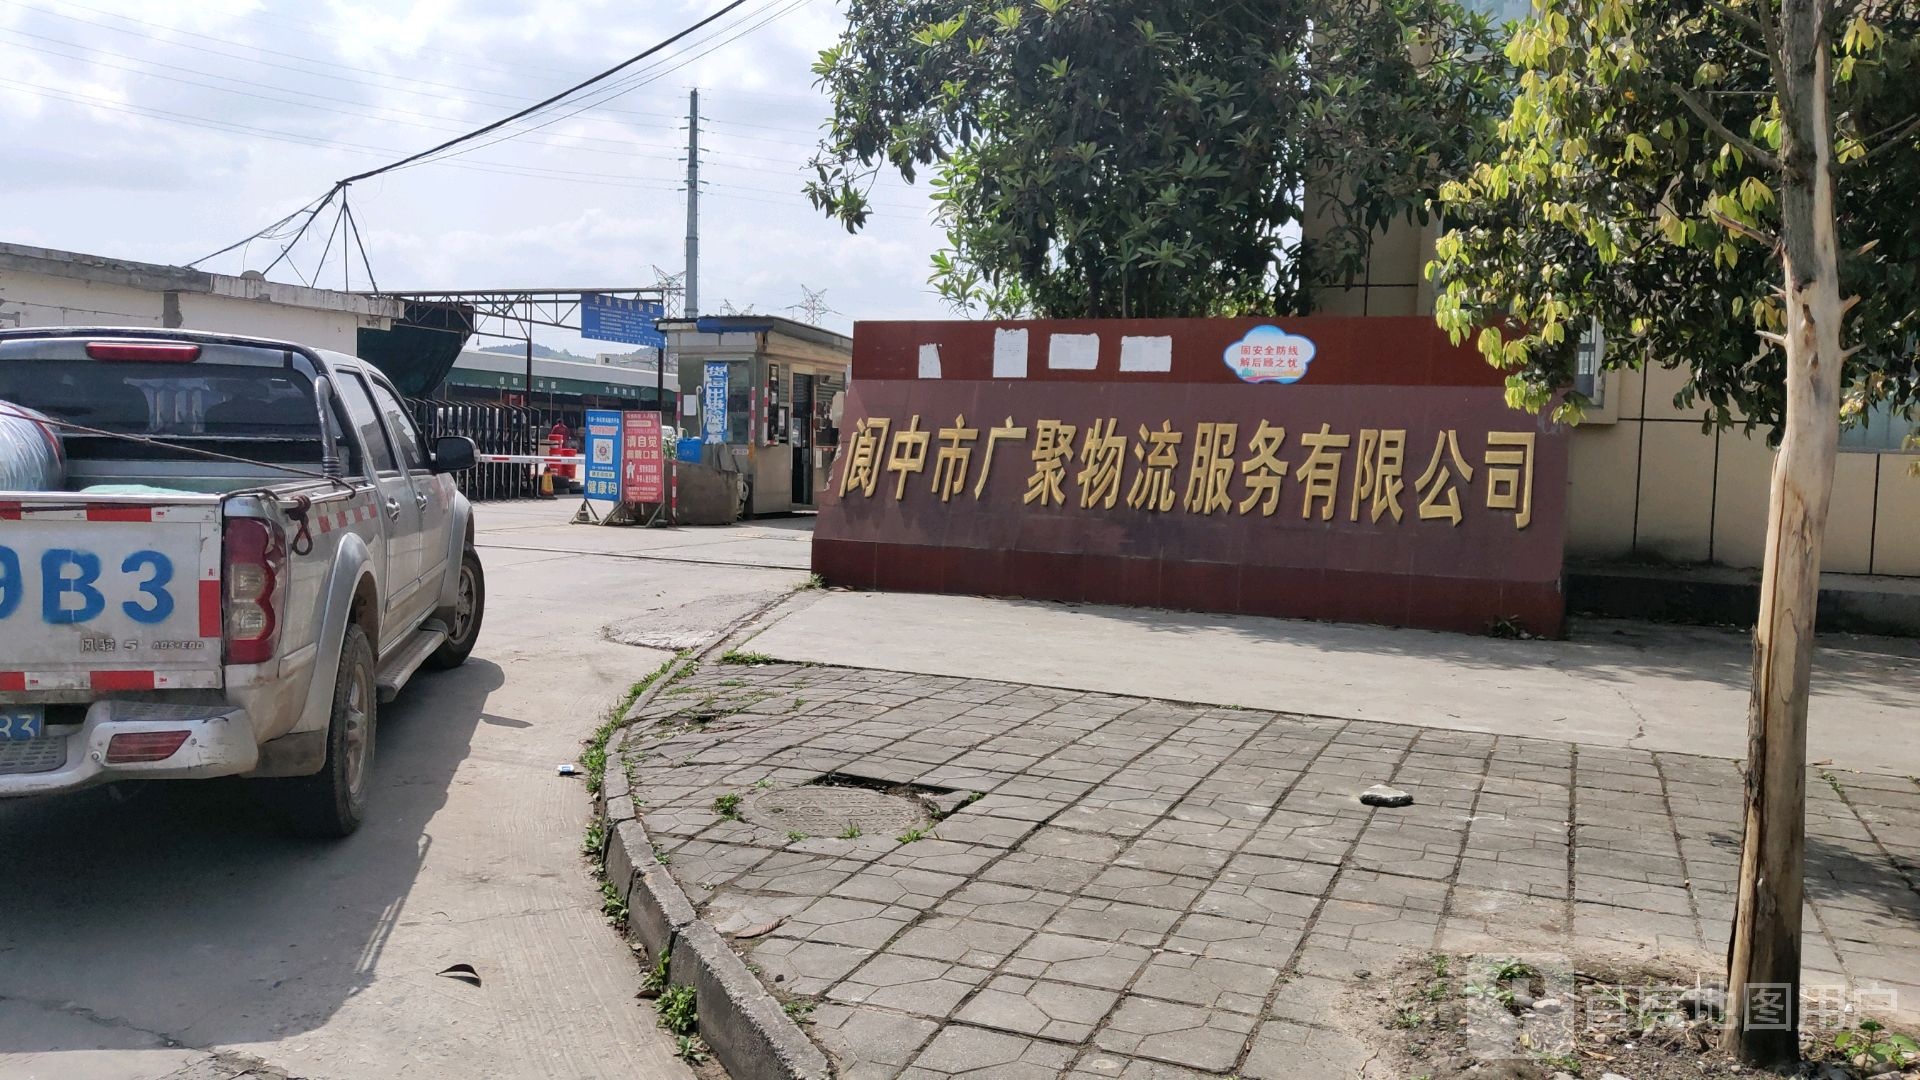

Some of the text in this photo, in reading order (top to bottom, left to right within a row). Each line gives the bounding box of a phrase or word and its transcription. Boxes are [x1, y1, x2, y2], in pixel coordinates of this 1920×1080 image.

[1240, 345, 1298, 356] 固安全防线
[1239, 357, 1298, 368] 解后顾之忧
[626, 435, 658, 448] 请自觉
[838, 415, 1536, 529] 阆中市广聚物流服务有限公司
[587, 480, 618, 496] 健康码
